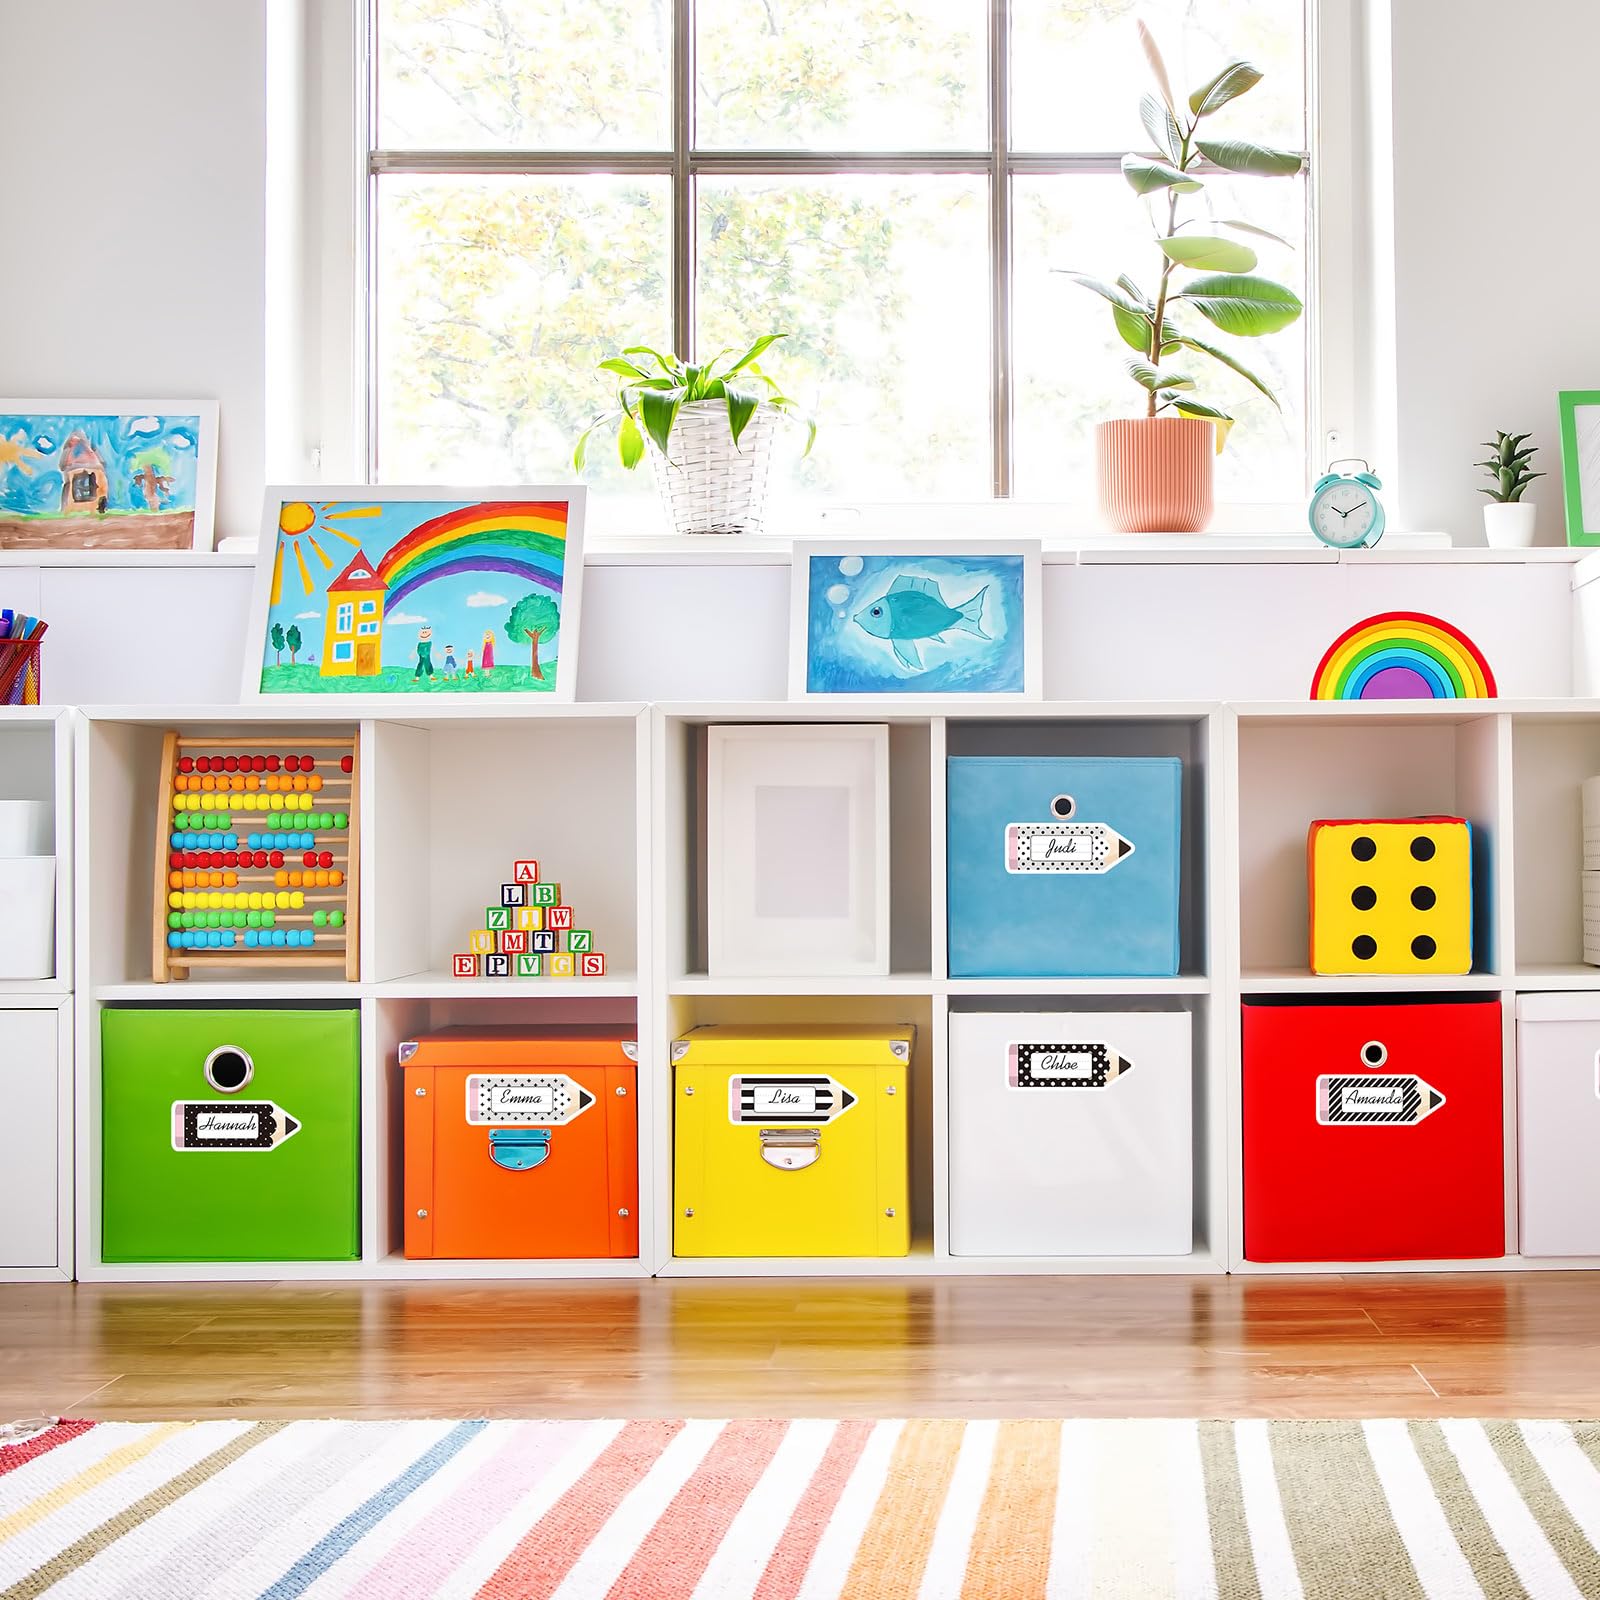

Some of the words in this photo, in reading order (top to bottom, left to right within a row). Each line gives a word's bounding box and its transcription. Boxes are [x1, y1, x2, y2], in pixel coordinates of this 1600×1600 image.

[1045, 838, 1077, 858] Judi
[518, 864, 533, 880] A
[506, 887, 519, 903] L
[538, 887, 552, 903] B
[491, 911, 504, 927] Z
[552, 910, 568, 926] W
[473, 934, 489, 950] U
[506, 934, 522, 949] M
[536, 933, 551, 949] T
[574, 934, 586, 949] Z
[457, 957, 471, 973] E
[492, 957, 505, 973] P
[523, 957, 537, 972] V
[554, 957, 569, 972] G
[587, 957, 600, 973] S
[1040, 1054, 1079, 1070] Chloe
[500, 1088, 543, 1104] Emma
[768, 1088, 801, 1104] Lisa
[1345, 1089, 1402, 1105] Amanda
[198, 1115, 257, 1131] Hannah
